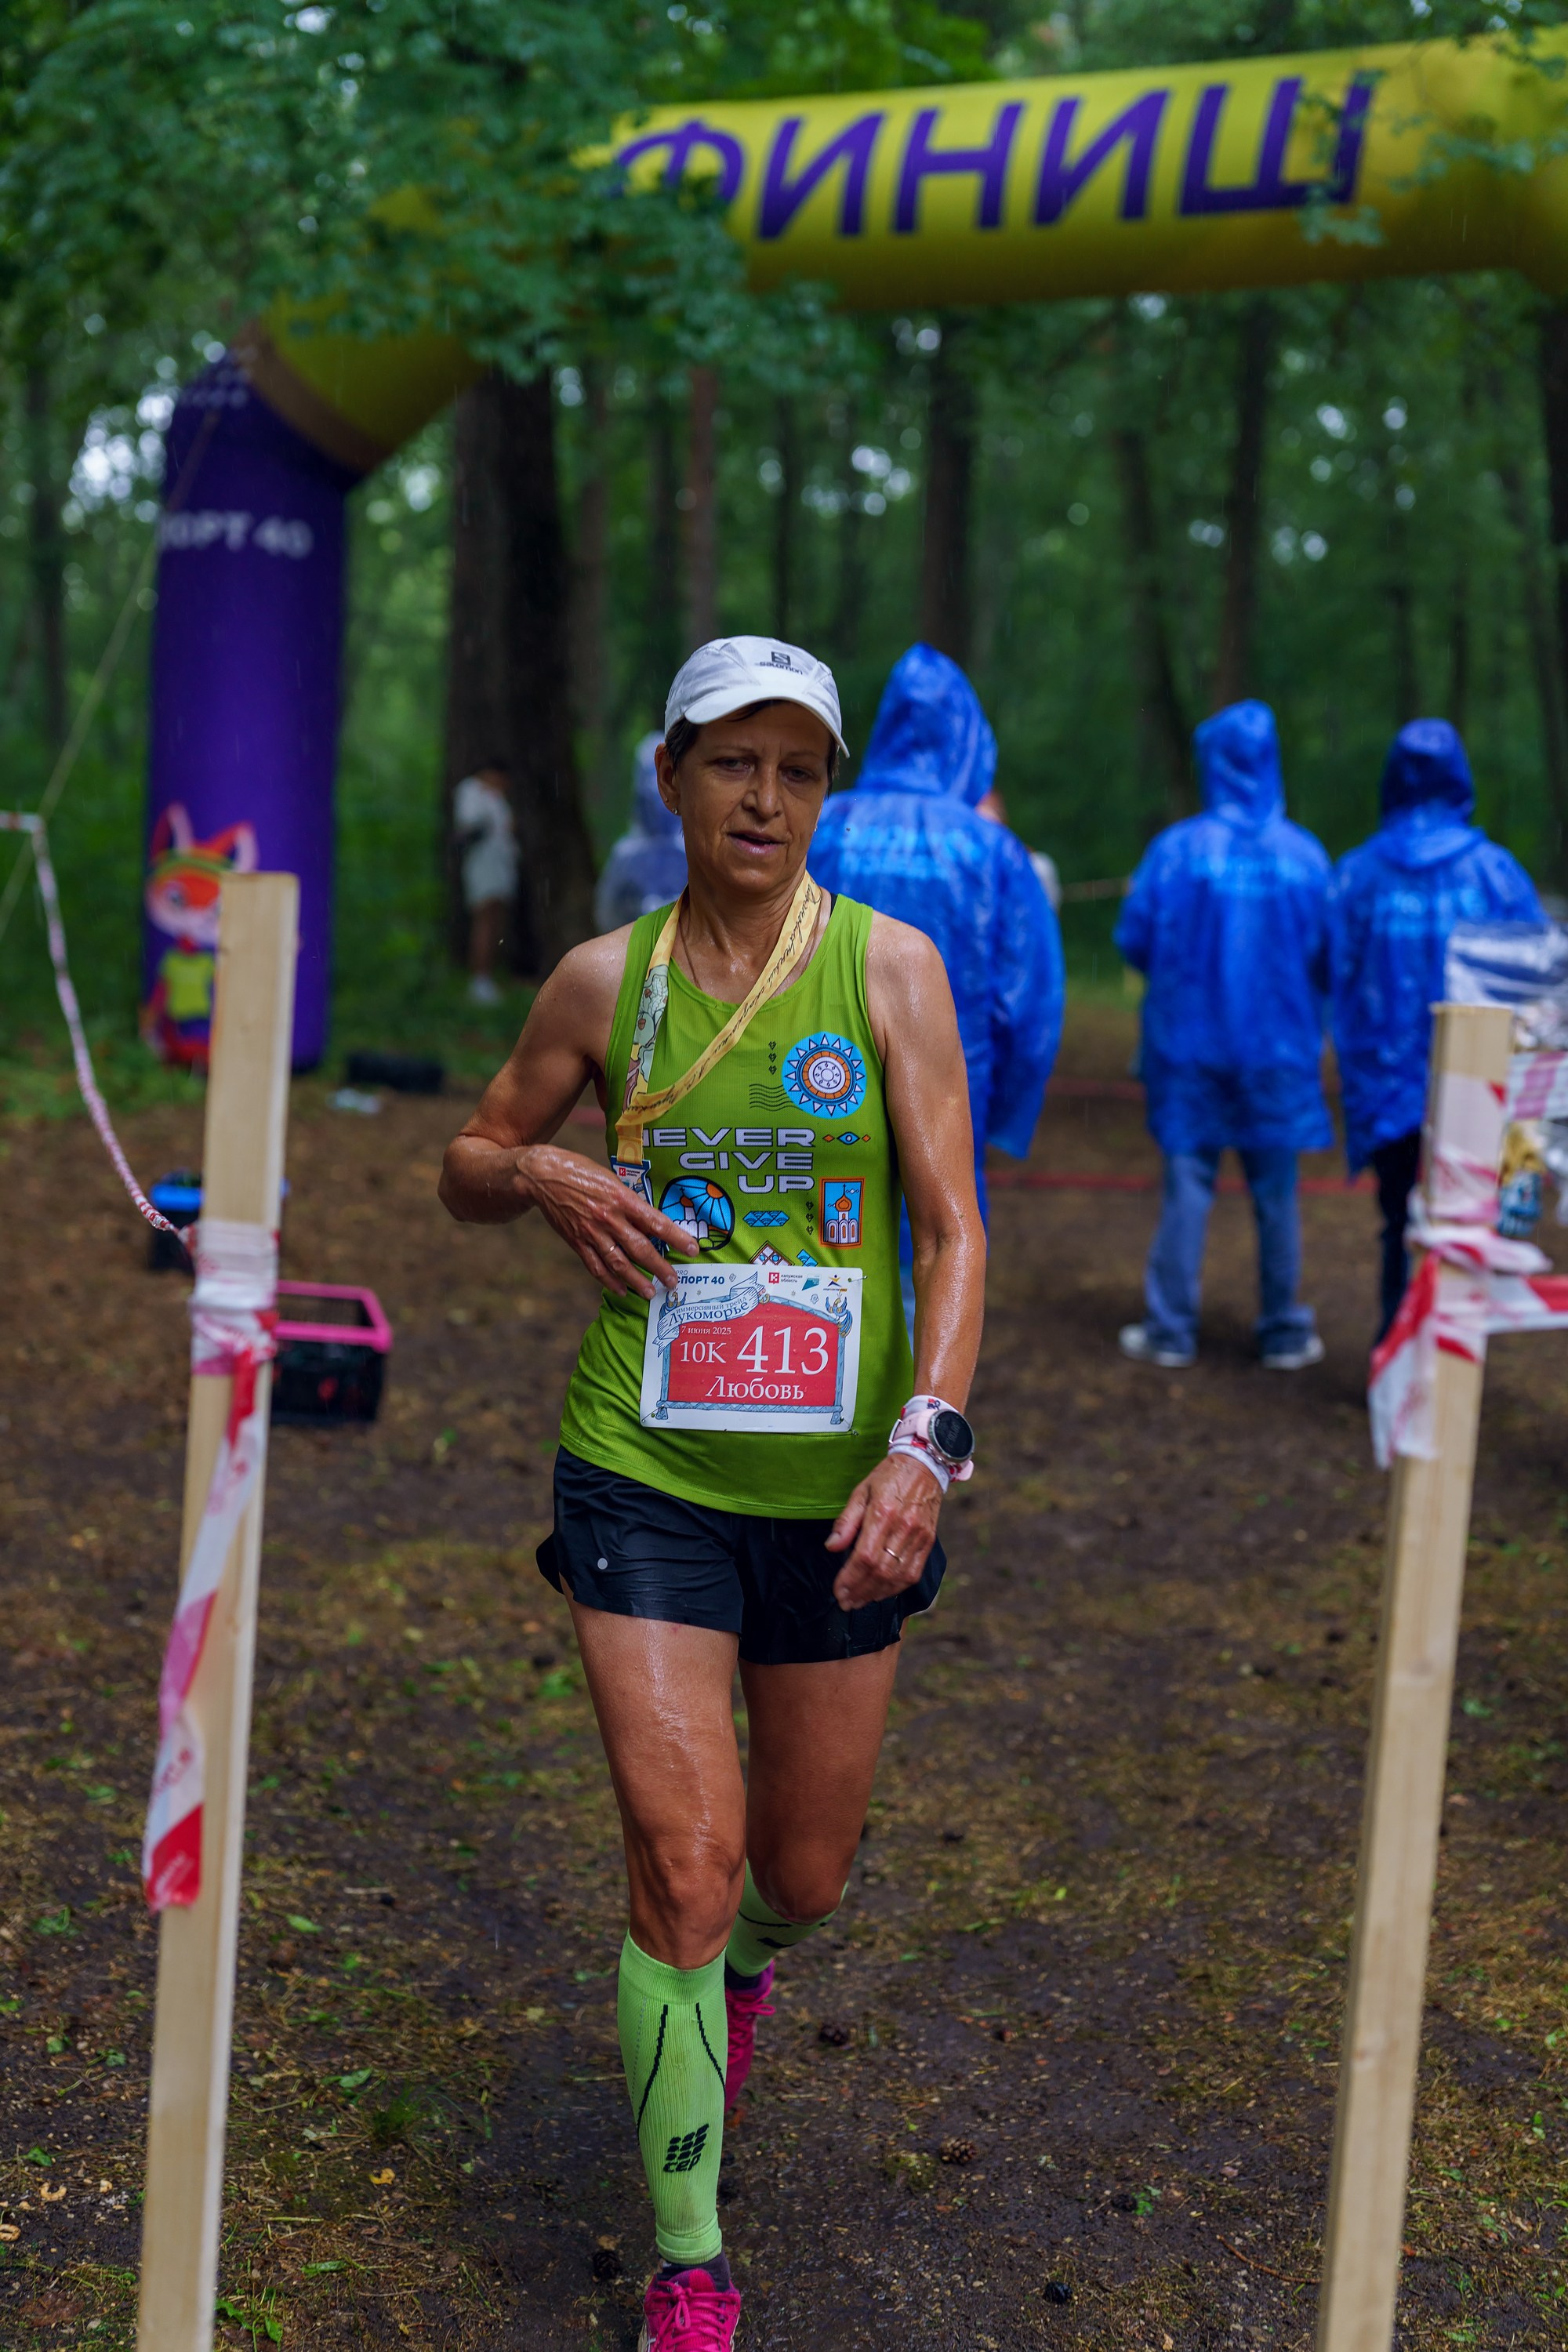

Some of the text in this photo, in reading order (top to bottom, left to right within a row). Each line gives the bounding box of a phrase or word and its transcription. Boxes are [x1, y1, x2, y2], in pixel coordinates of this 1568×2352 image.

[615, 69, 1377, 241] ФИНИШ
[759, 661, 803, 675] salomon
[679, 1151, 813, 1171] GIVE
[738, 1174, 815, 1194] UP
[710, 1276, 725, 1285] 40
[669, 1301, 750, 1327] Лукоморье
[676, 1303, 724, 1314] иммерсивный
[712, 1327, 731, 1335] 2025
[736, 1325, 829, 1376] 413
[705, 1376, 804, 1400] Любовь
[662, 2153, 702, 2172] cep
